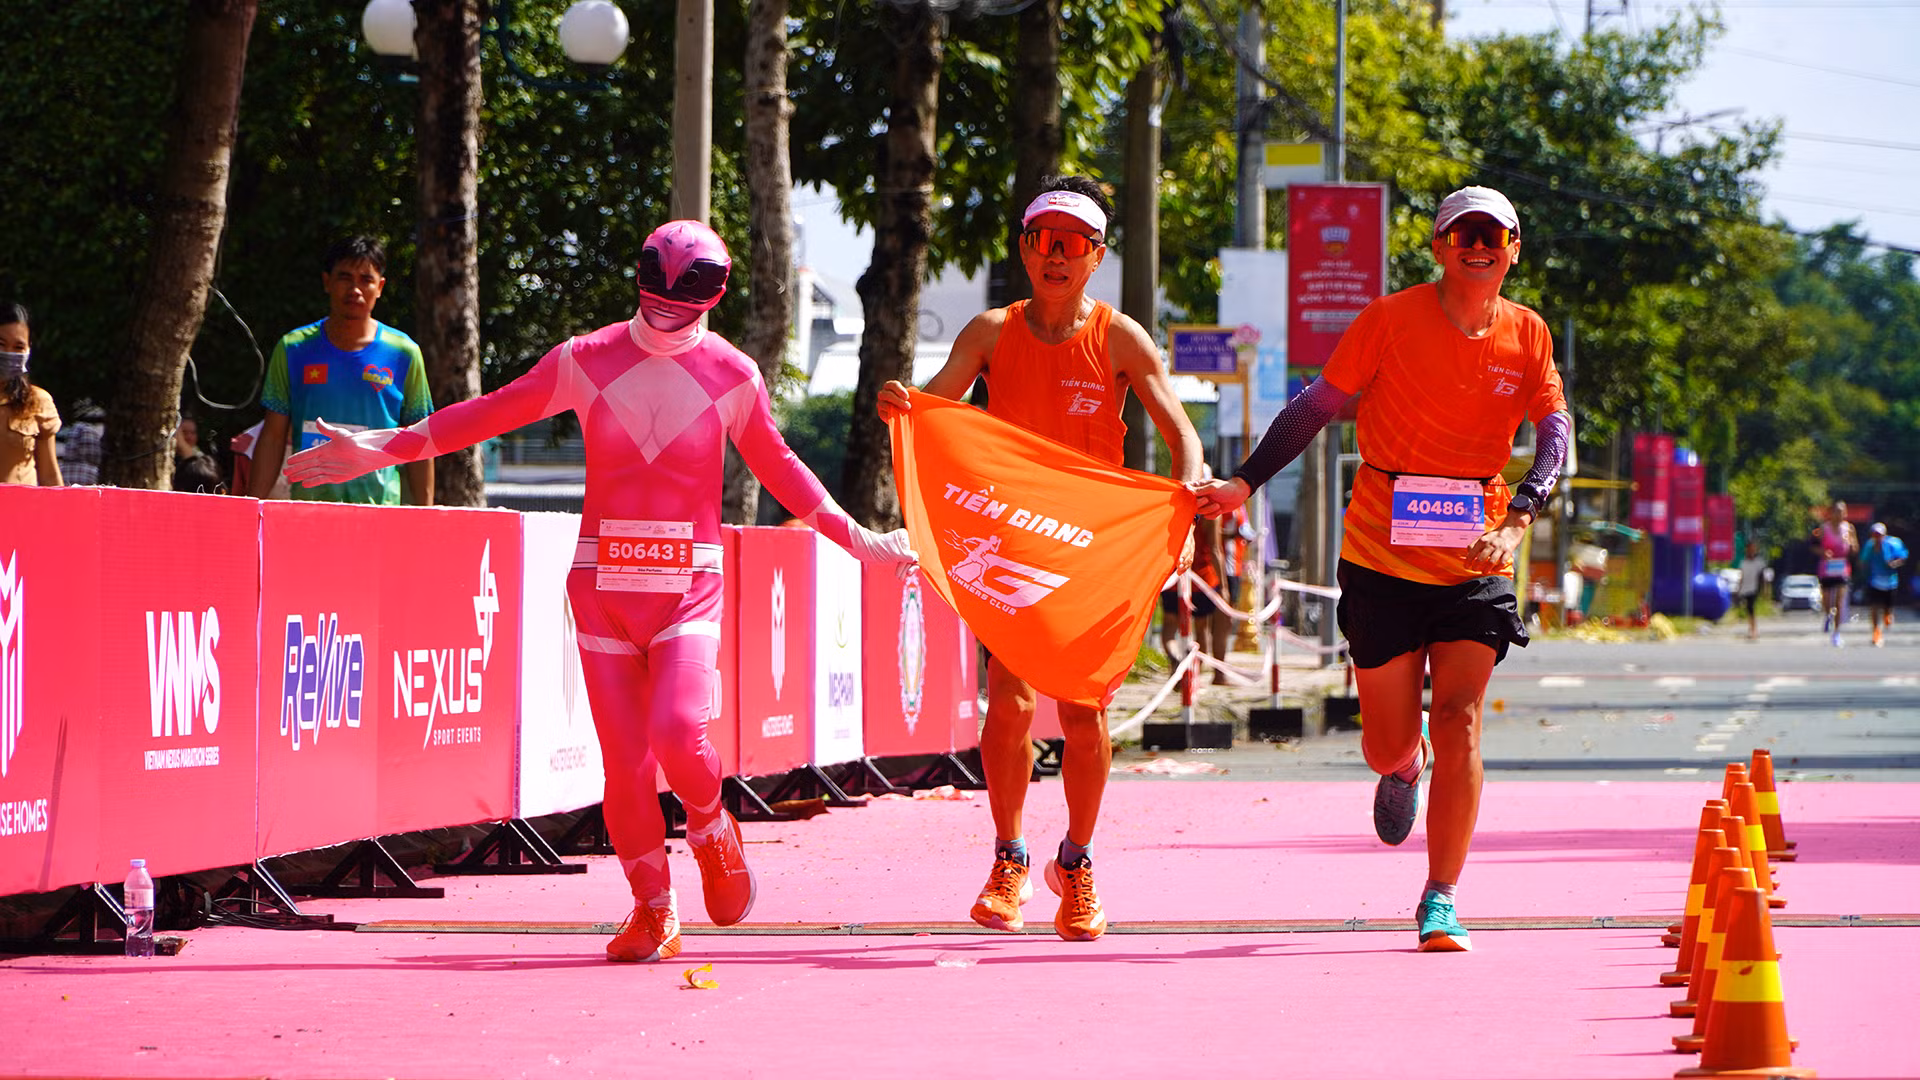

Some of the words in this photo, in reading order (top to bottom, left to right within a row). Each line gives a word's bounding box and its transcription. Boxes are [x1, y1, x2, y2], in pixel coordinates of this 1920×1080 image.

[1407, 499, 1465, 516] 40486
[1007, 508, 1094, 548] GIANG
[608, 541, 674, 560] 50643
[947, 569, 989, 601] RUNNERS
[989, 597, 1017, 616] CLUB
[145, 606, 221, 737] VNMS
[393, 647, 483, 751] NEXUS
[433, 728, 455, 746] SPORT
[457, 726, 481, 744] EVENTS
[205, 746, 219, 766] SERIES
[13, 798, 48, 835] HOMES
